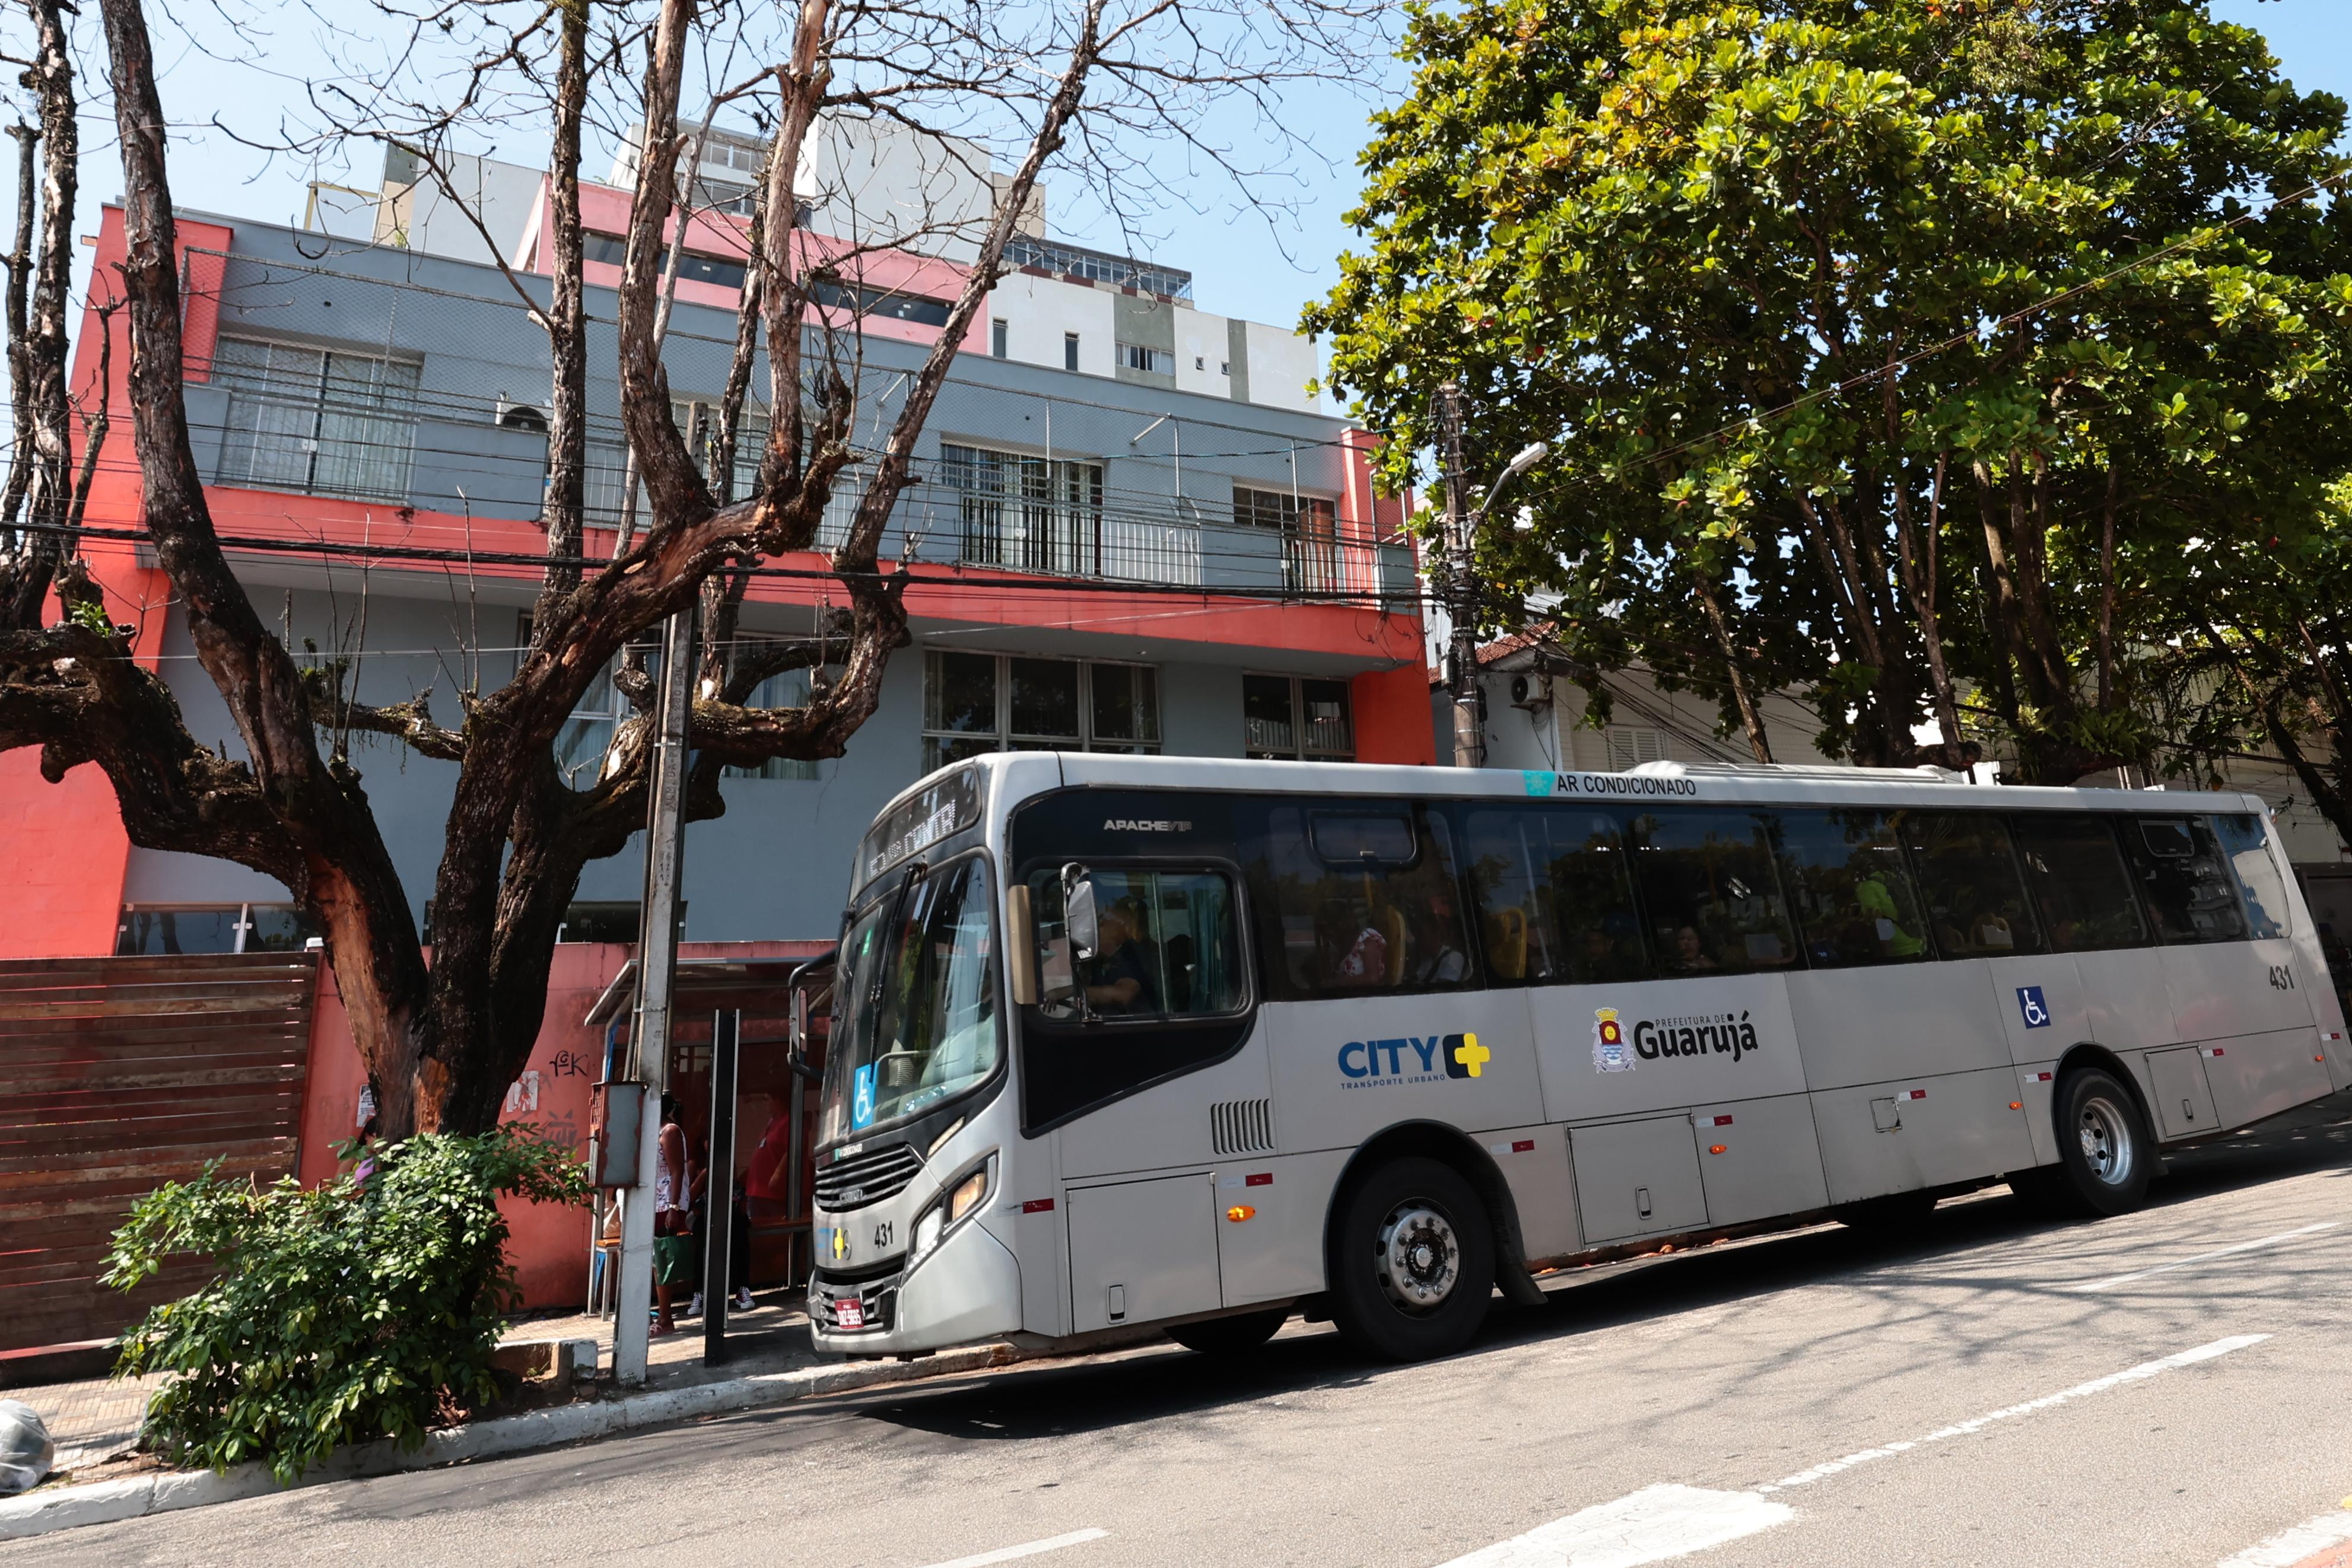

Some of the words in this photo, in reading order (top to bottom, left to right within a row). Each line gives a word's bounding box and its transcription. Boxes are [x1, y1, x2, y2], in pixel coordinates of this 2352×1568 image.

[1558, 775, 1579, 792] AR
[1584, 775, 1696, 796] CONDICIONADO
[2270, 965, 2294, 990] 431
[1655, 1016, 1711, 1028] PREFEITURA
[1715, 1014, 1725, 1023] DE
[1633, 1010, 1758, 1063] Guarujá
[1340, 1078, 1403, 1090] TRANSPORTE
[1408, 1074, 1445, 1084] URBANO
[875, 1220, 894, 1249] 431
